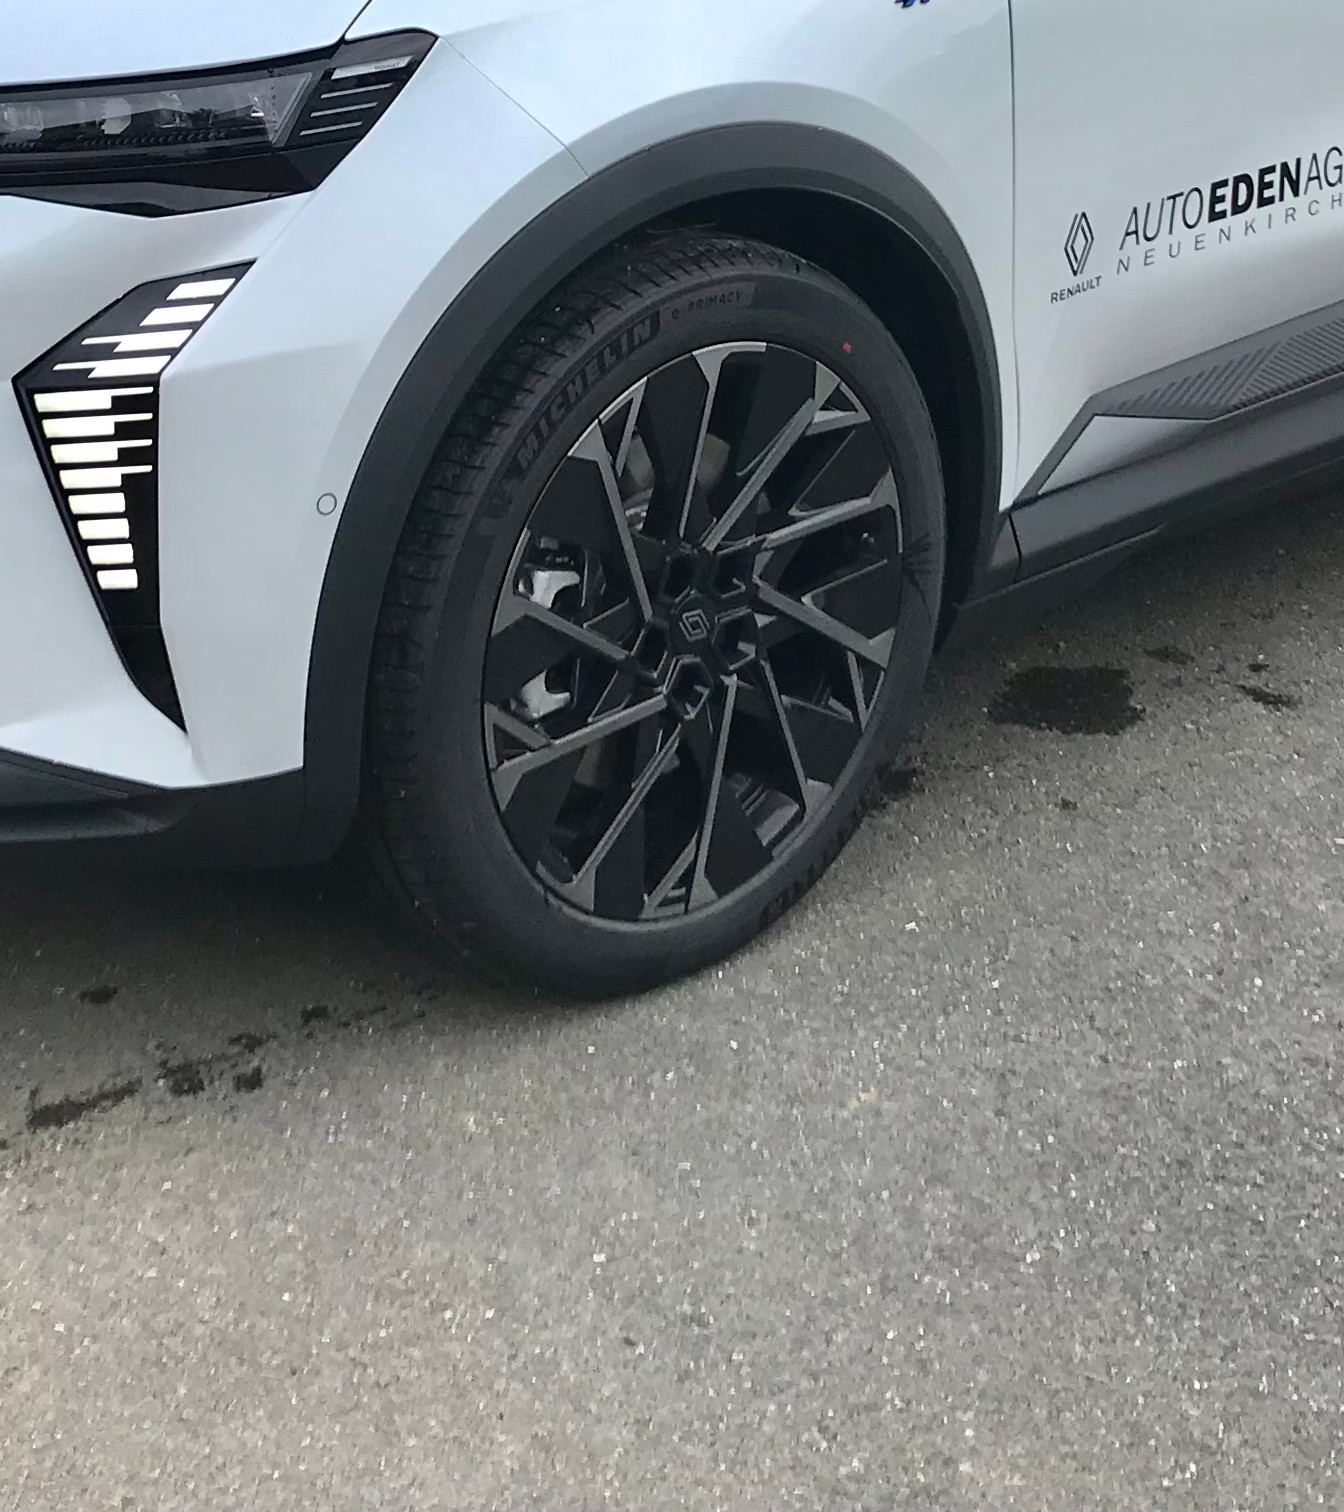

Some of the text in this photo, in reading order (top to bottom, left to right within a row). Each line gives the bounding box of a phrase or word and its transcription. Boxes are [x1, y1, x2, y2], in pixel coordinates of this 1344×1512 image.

[1116, 192, 1344, 275] NEUENKIRCH
[1049, 274, 1102, 304] RENAULT
[515, 316, 652, 471] MICHELIN
